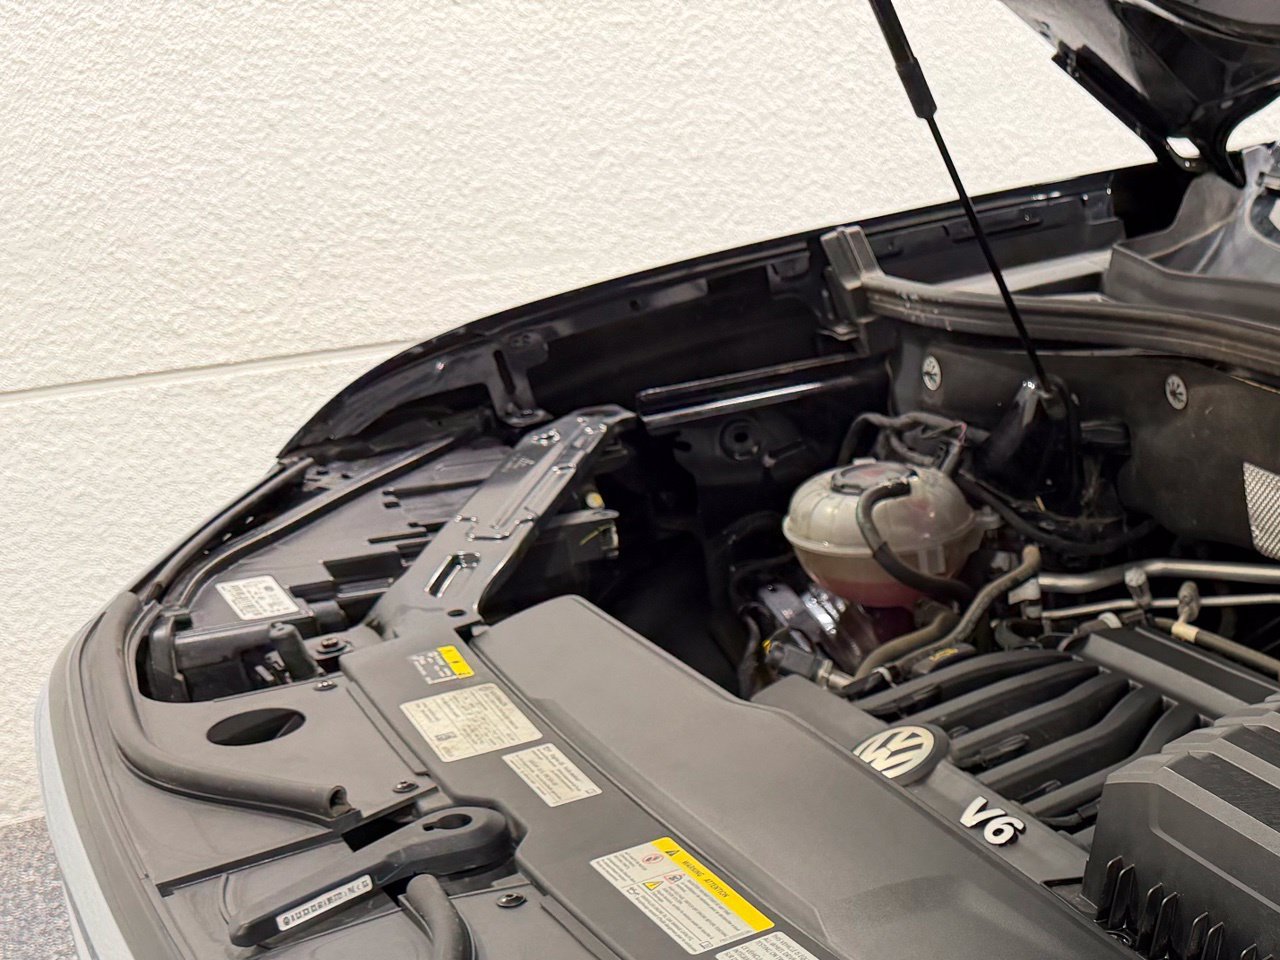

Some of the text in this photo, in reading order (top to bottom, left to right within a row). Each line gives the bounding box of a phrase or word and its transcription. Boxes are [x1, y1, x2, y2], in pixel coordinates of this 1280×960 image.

[960, 796, 1026, 845] V6
[682, 860, 730, 899] WARNING ATTENTION
